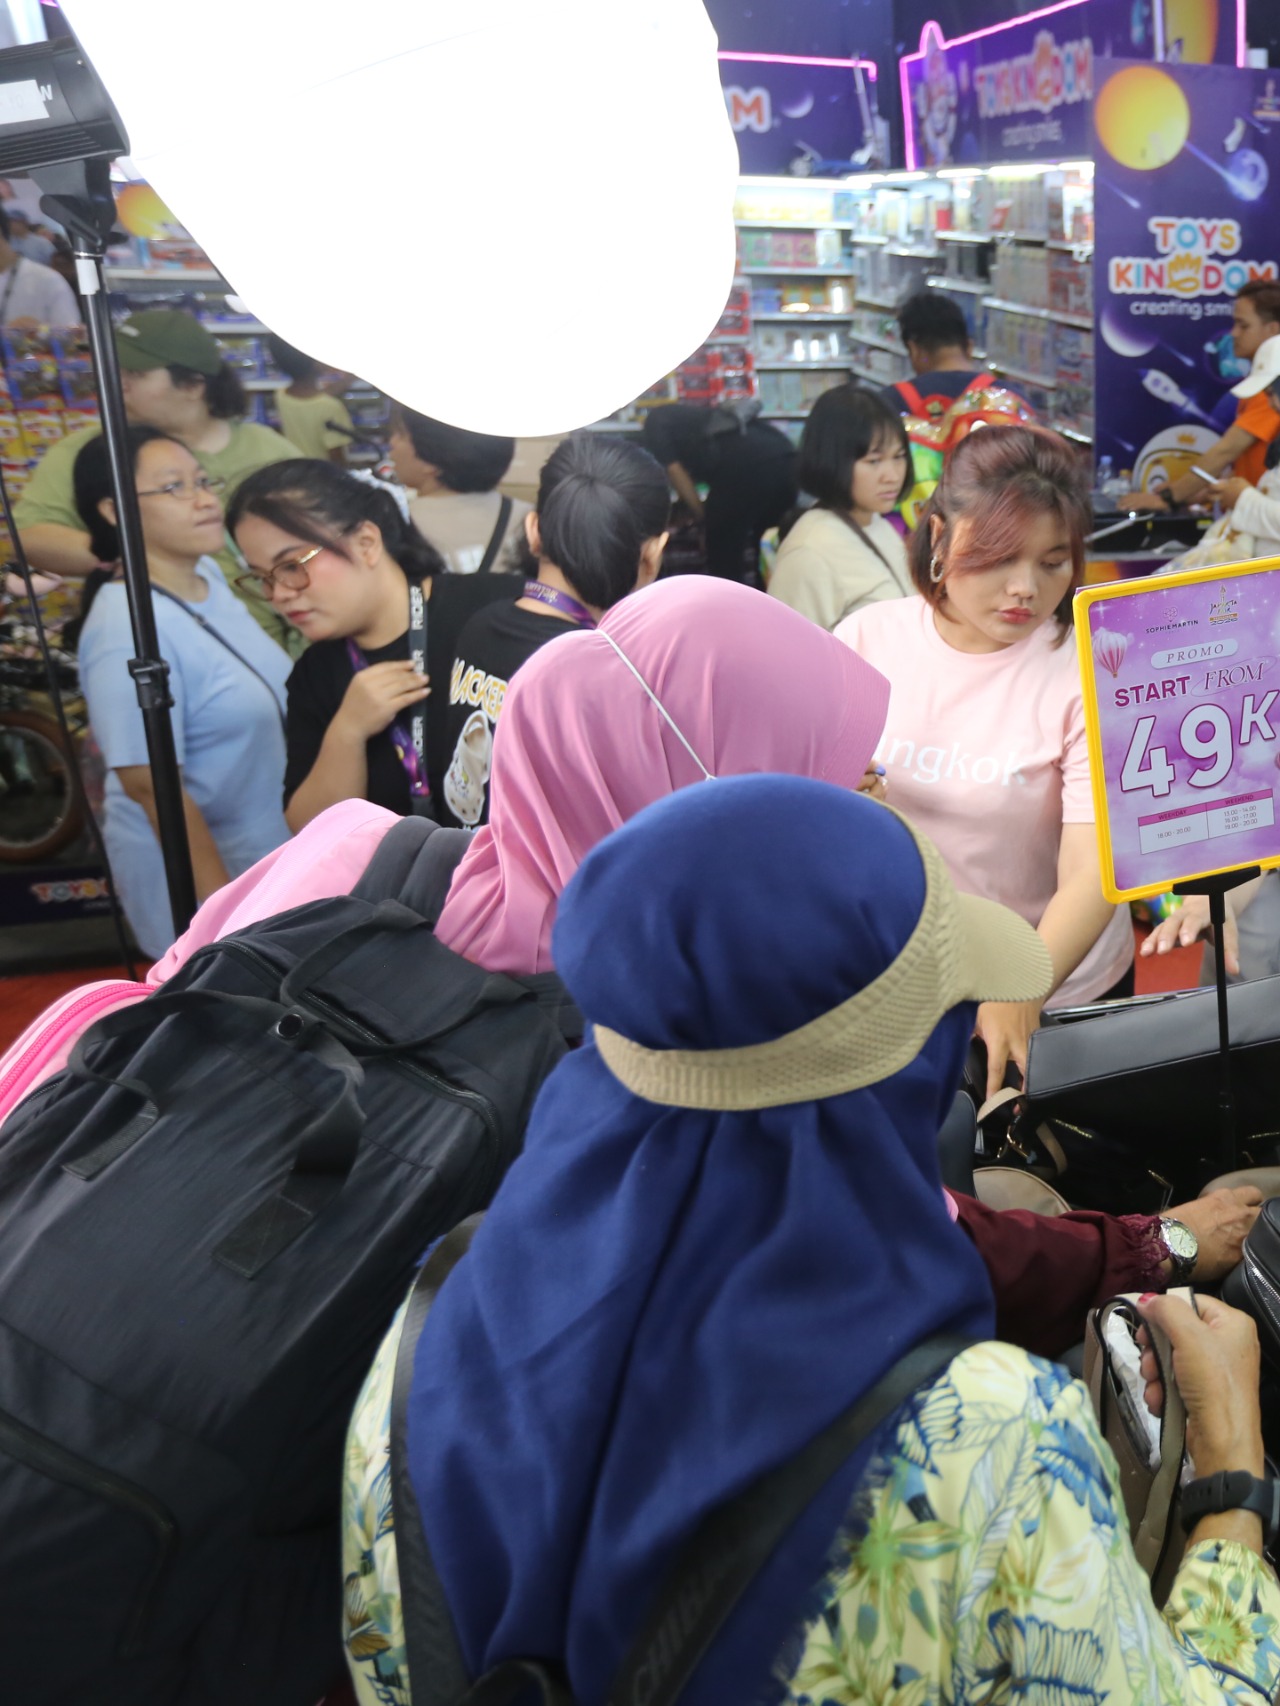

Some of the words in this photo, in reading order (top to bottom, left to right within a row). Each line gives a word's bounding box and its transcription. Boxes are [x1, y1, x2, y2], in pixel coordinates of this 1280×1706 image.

[1152, 219, 1239, 253] TOYS
[1130, 300, 1203, 320] creating
[410, 586, 423, 630] RIDER
[1166, 643, 1224, 663] PROMO
[1114, 676, 1190, 707] START
[1204, 662, 1264, 689] FROM
[412, 716, 424, 763] DER
[1120, 689, 1280, 797] 49K
[1225, 795, 1254, 805] WEEKEND
[1158, 810, 1186, 820] WEEKDAY
[30, 880, 98, 903] TOYS
